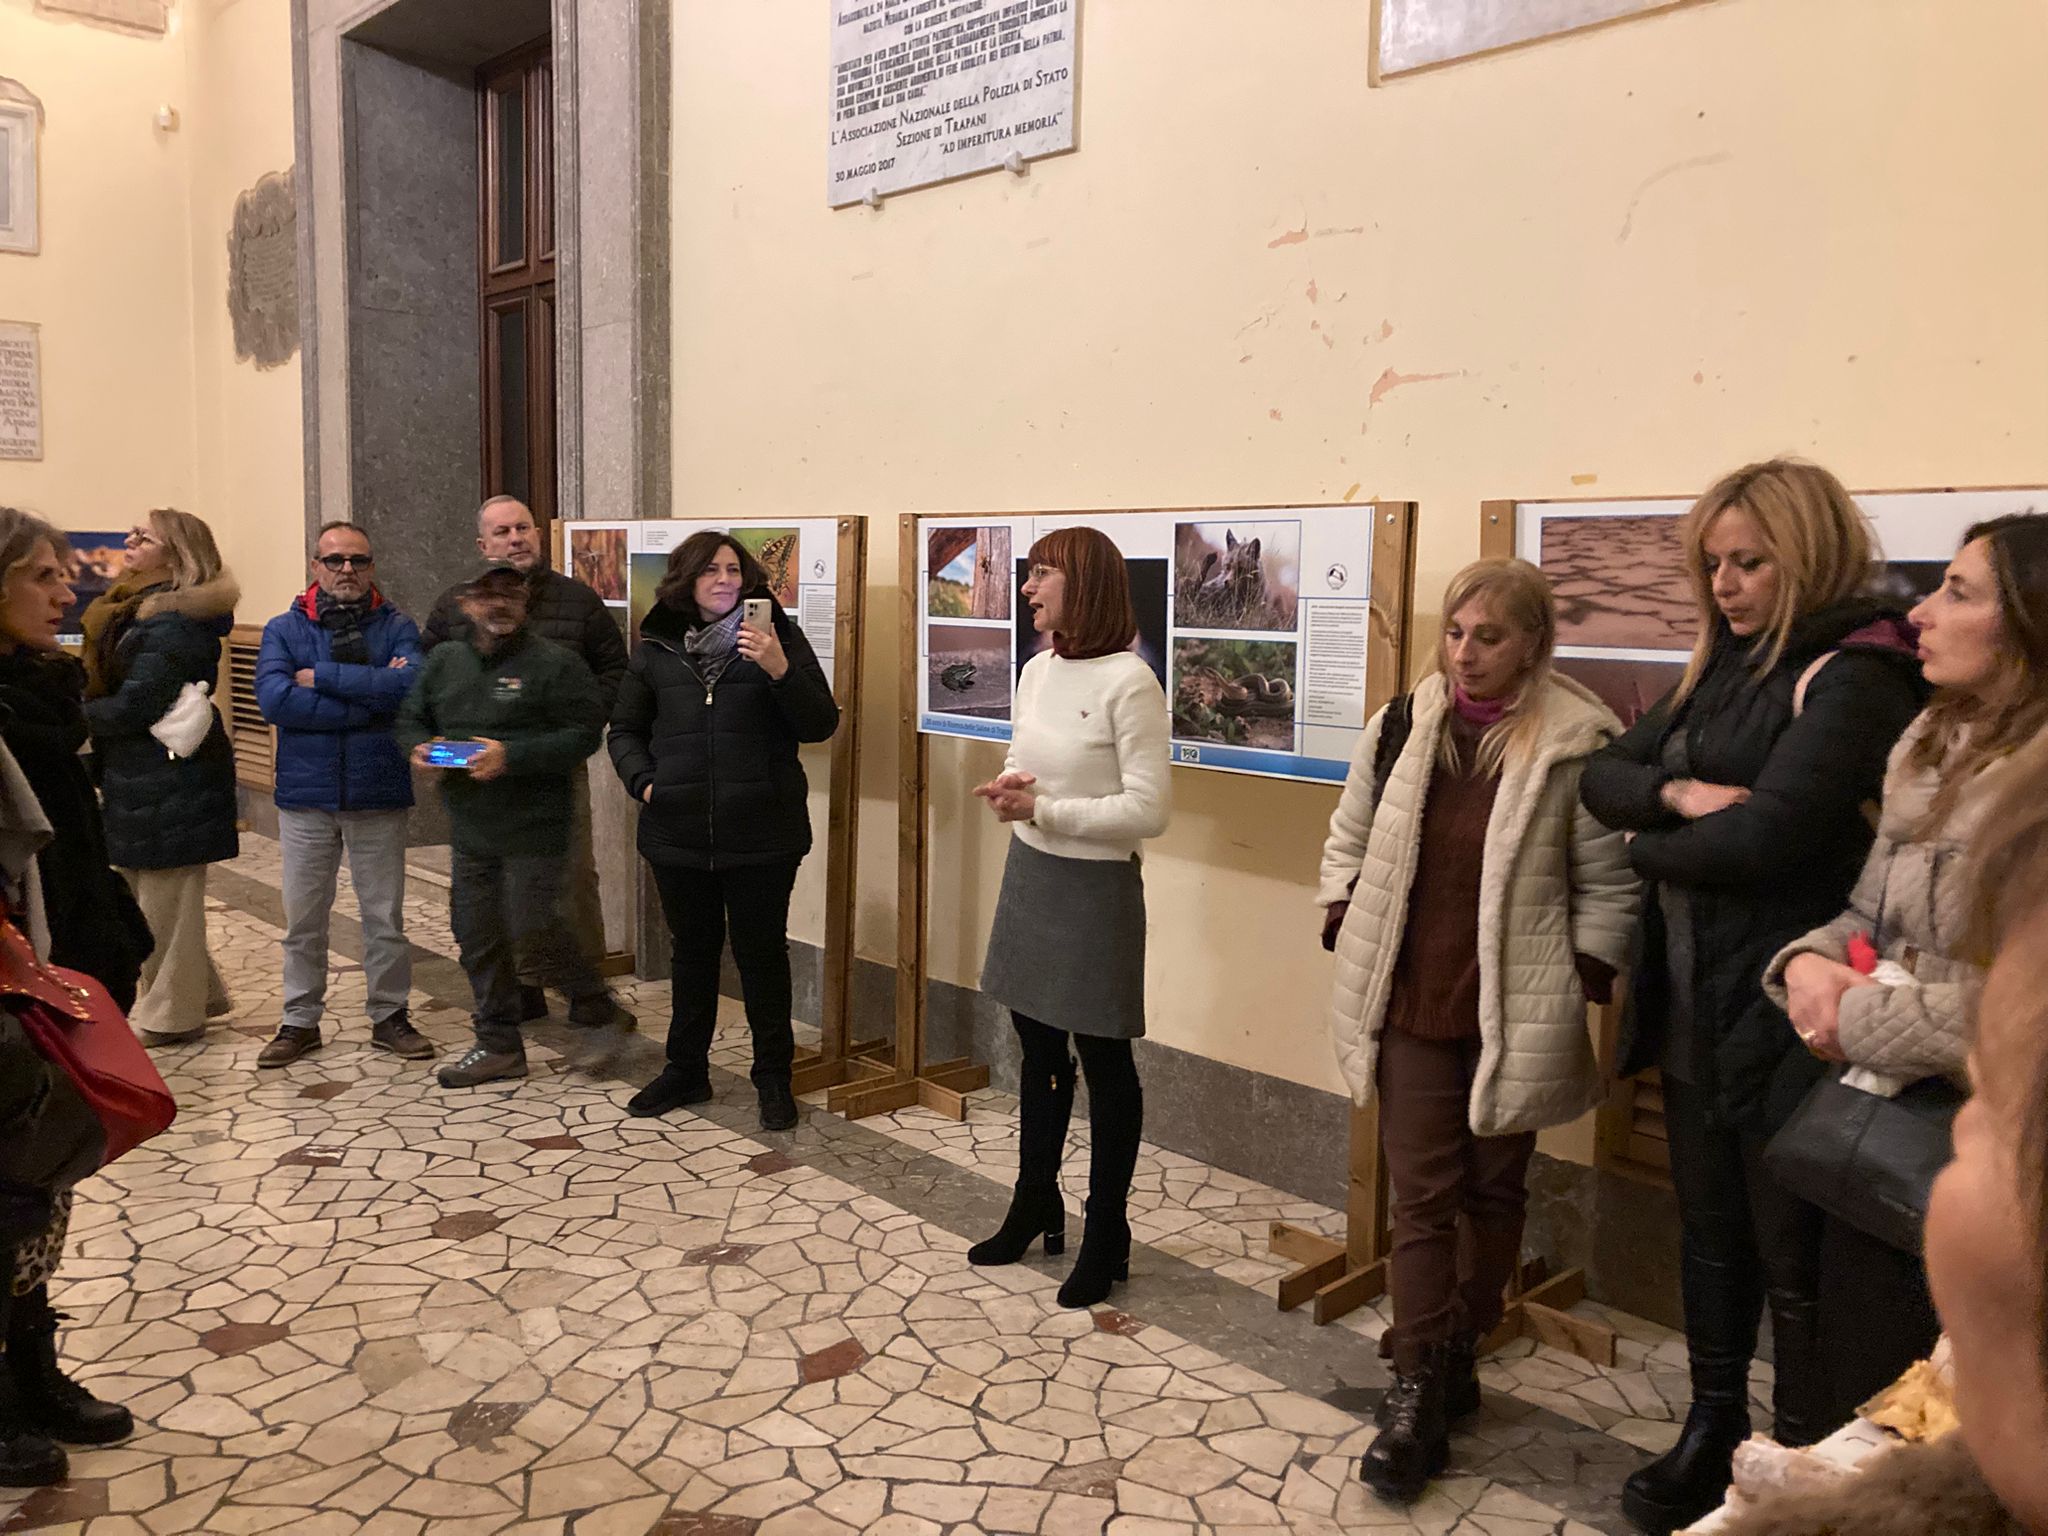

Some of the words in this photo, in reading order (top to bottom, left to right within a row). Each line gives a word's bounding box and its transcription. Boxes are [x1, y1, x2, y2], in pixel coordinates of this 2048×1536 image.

[900, 102, 951, 127] NAZIONALE
[953, 94, 980, 111] DELLA
[983, 82, 1020, 103] POLIZIA
[1023, 77, 1033, 91] DI
[1036, 67, 1069, 88] STATO
[896, 128, 932, 148] SEZIONE
[934, 125, 943, 138] DI
[945, 112, 987, 135] TRAPANI
[957, 126, 1012, 151] IMPERITURA
[835, 171, 845, 183] 30
[846, 161, 877, 181] MAGGIO
[878, 157, 896, 172] 2017
